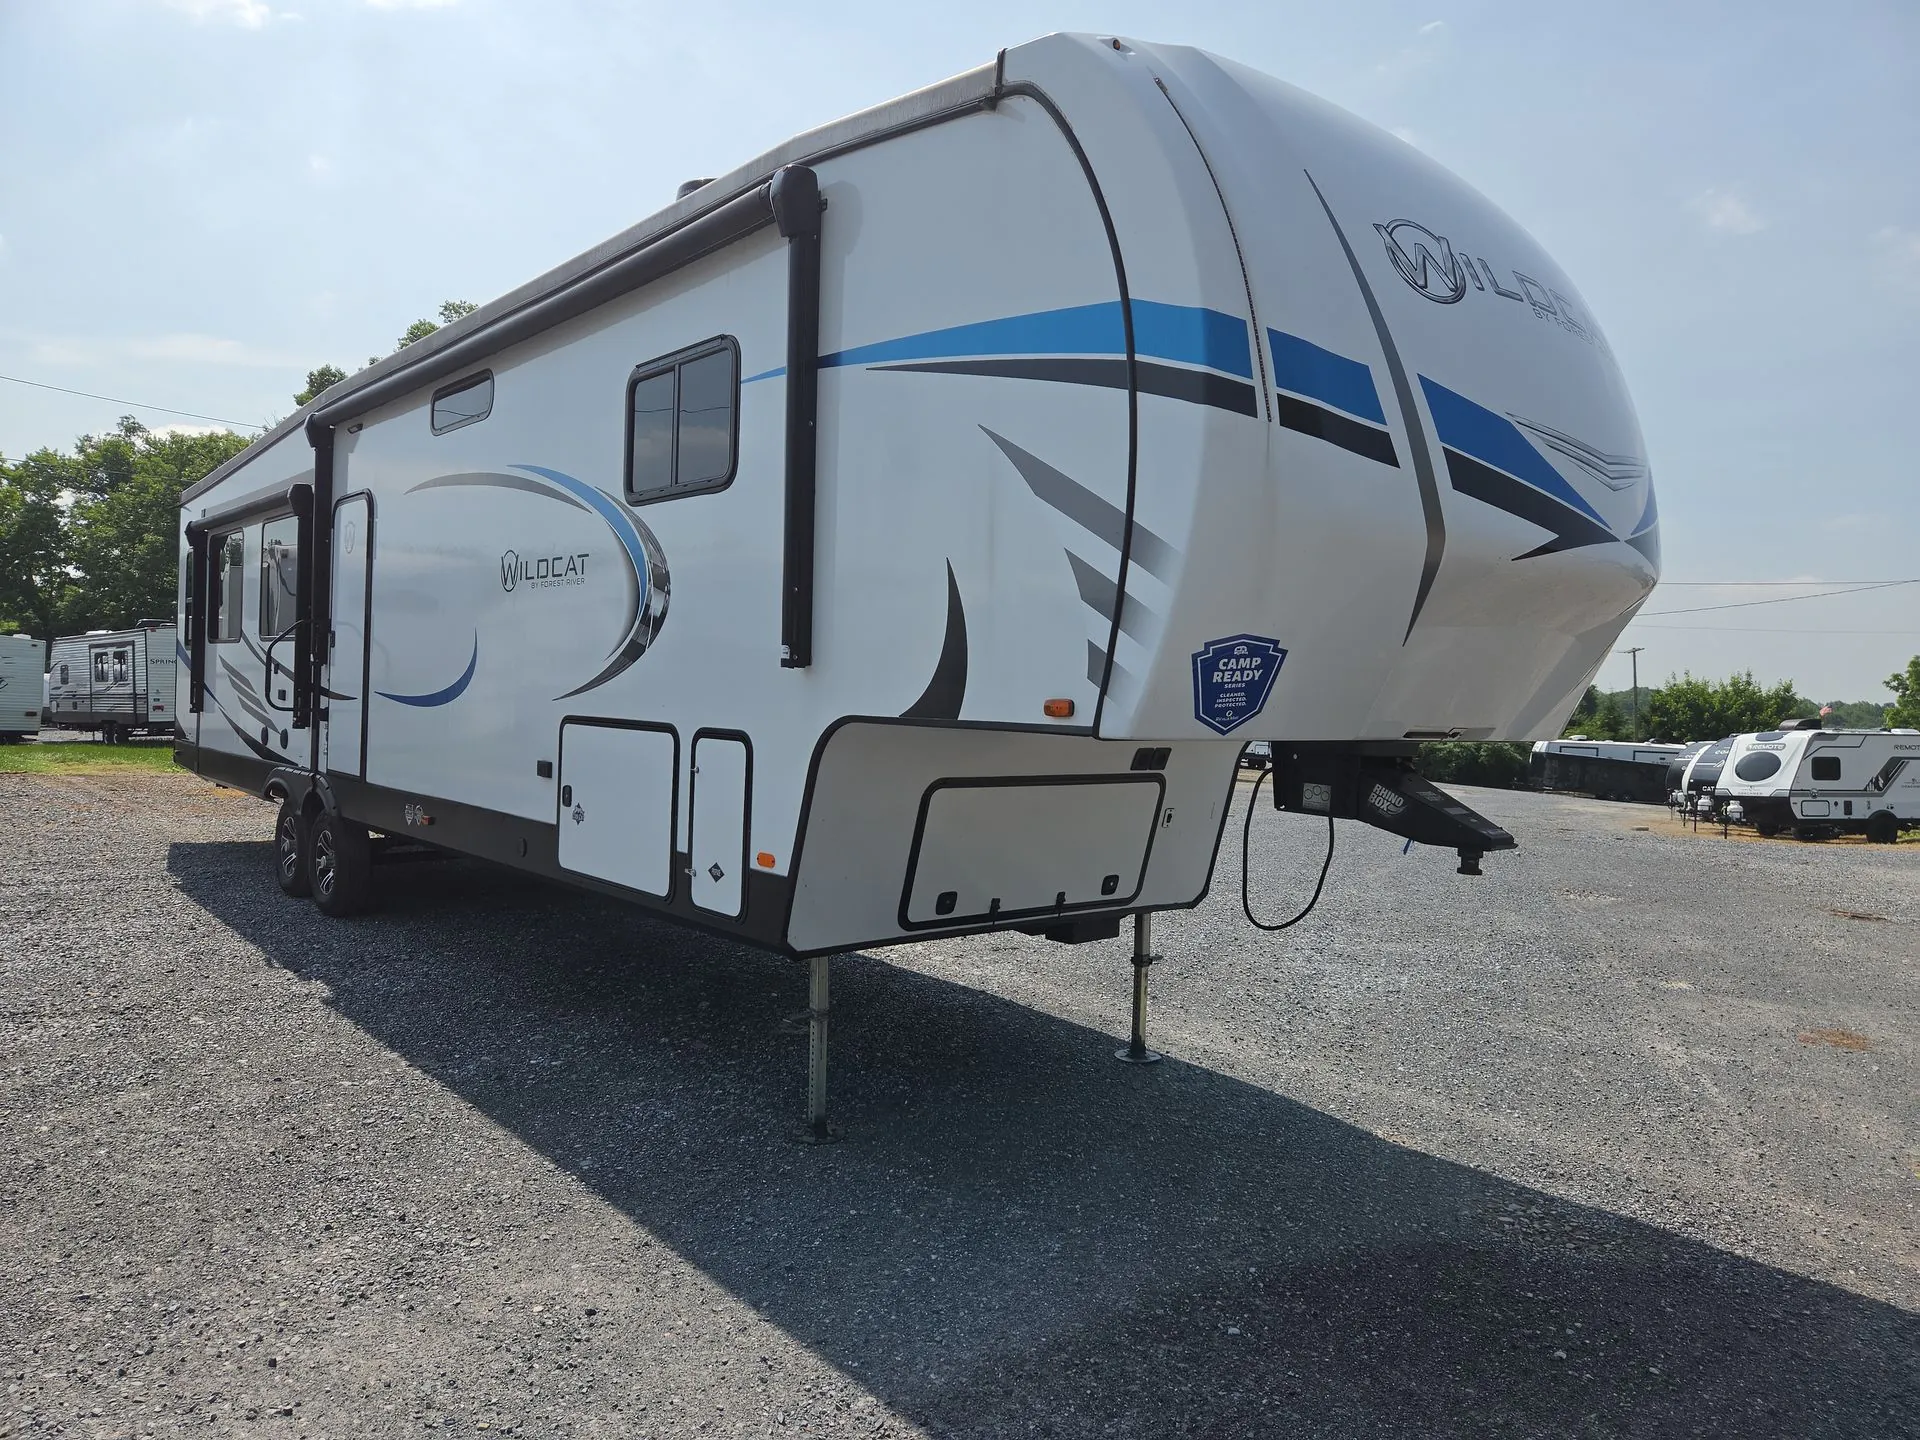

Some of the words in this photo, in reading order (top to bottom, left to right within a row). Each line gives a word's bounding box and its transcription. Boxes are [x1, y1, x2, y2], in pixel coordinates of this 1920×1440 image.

[501, 549, 590, 592] WILDCAT
[541, 579, 564, 588] FOREST
[566, 577, 585, 586] RIVER
[1218, 657, 1262, 670] CAMP
[1212, 669, 1263, 683] READY
[1368, 792, 1391, 811] BOX
[1372, 783, 1404, 807] RHINO
